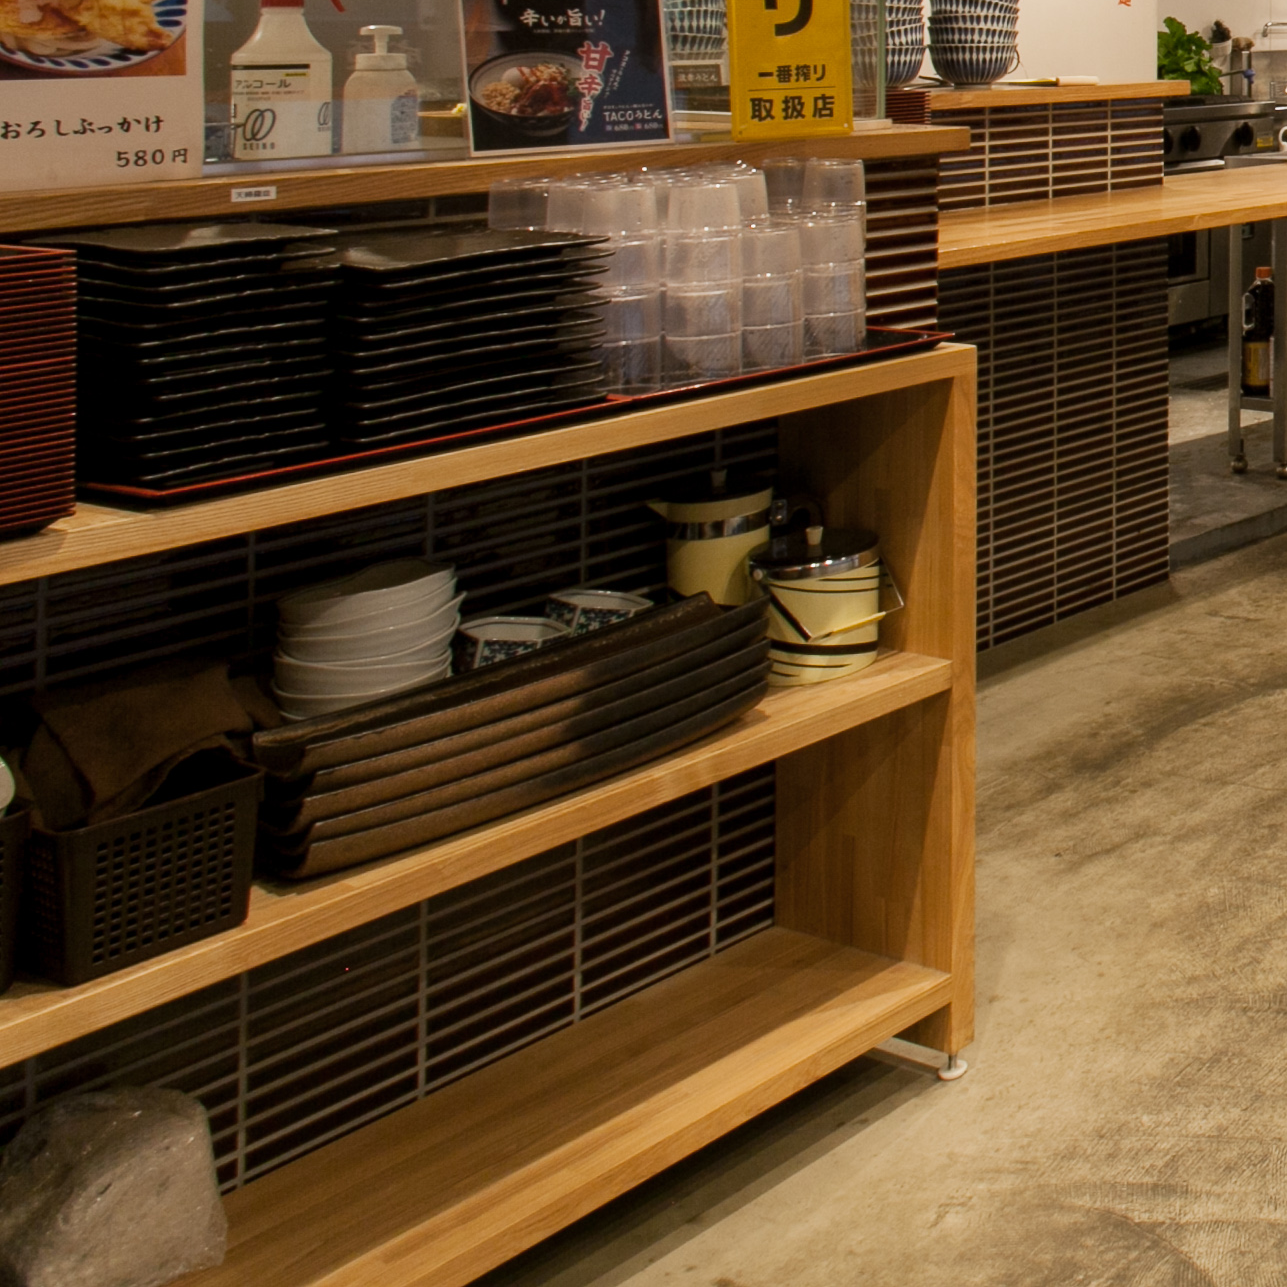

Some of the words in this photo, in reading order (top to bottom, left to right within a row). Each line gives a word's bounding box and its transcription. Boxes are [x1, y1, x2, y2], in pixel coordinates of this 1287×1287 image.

[758, 64, 827, 84] 一番搾り
[749, 94, 835, 122] 取扱店
[1, 115, 164, 140] おろしぶっかけ
[115, 147, 189, 168] 580円
